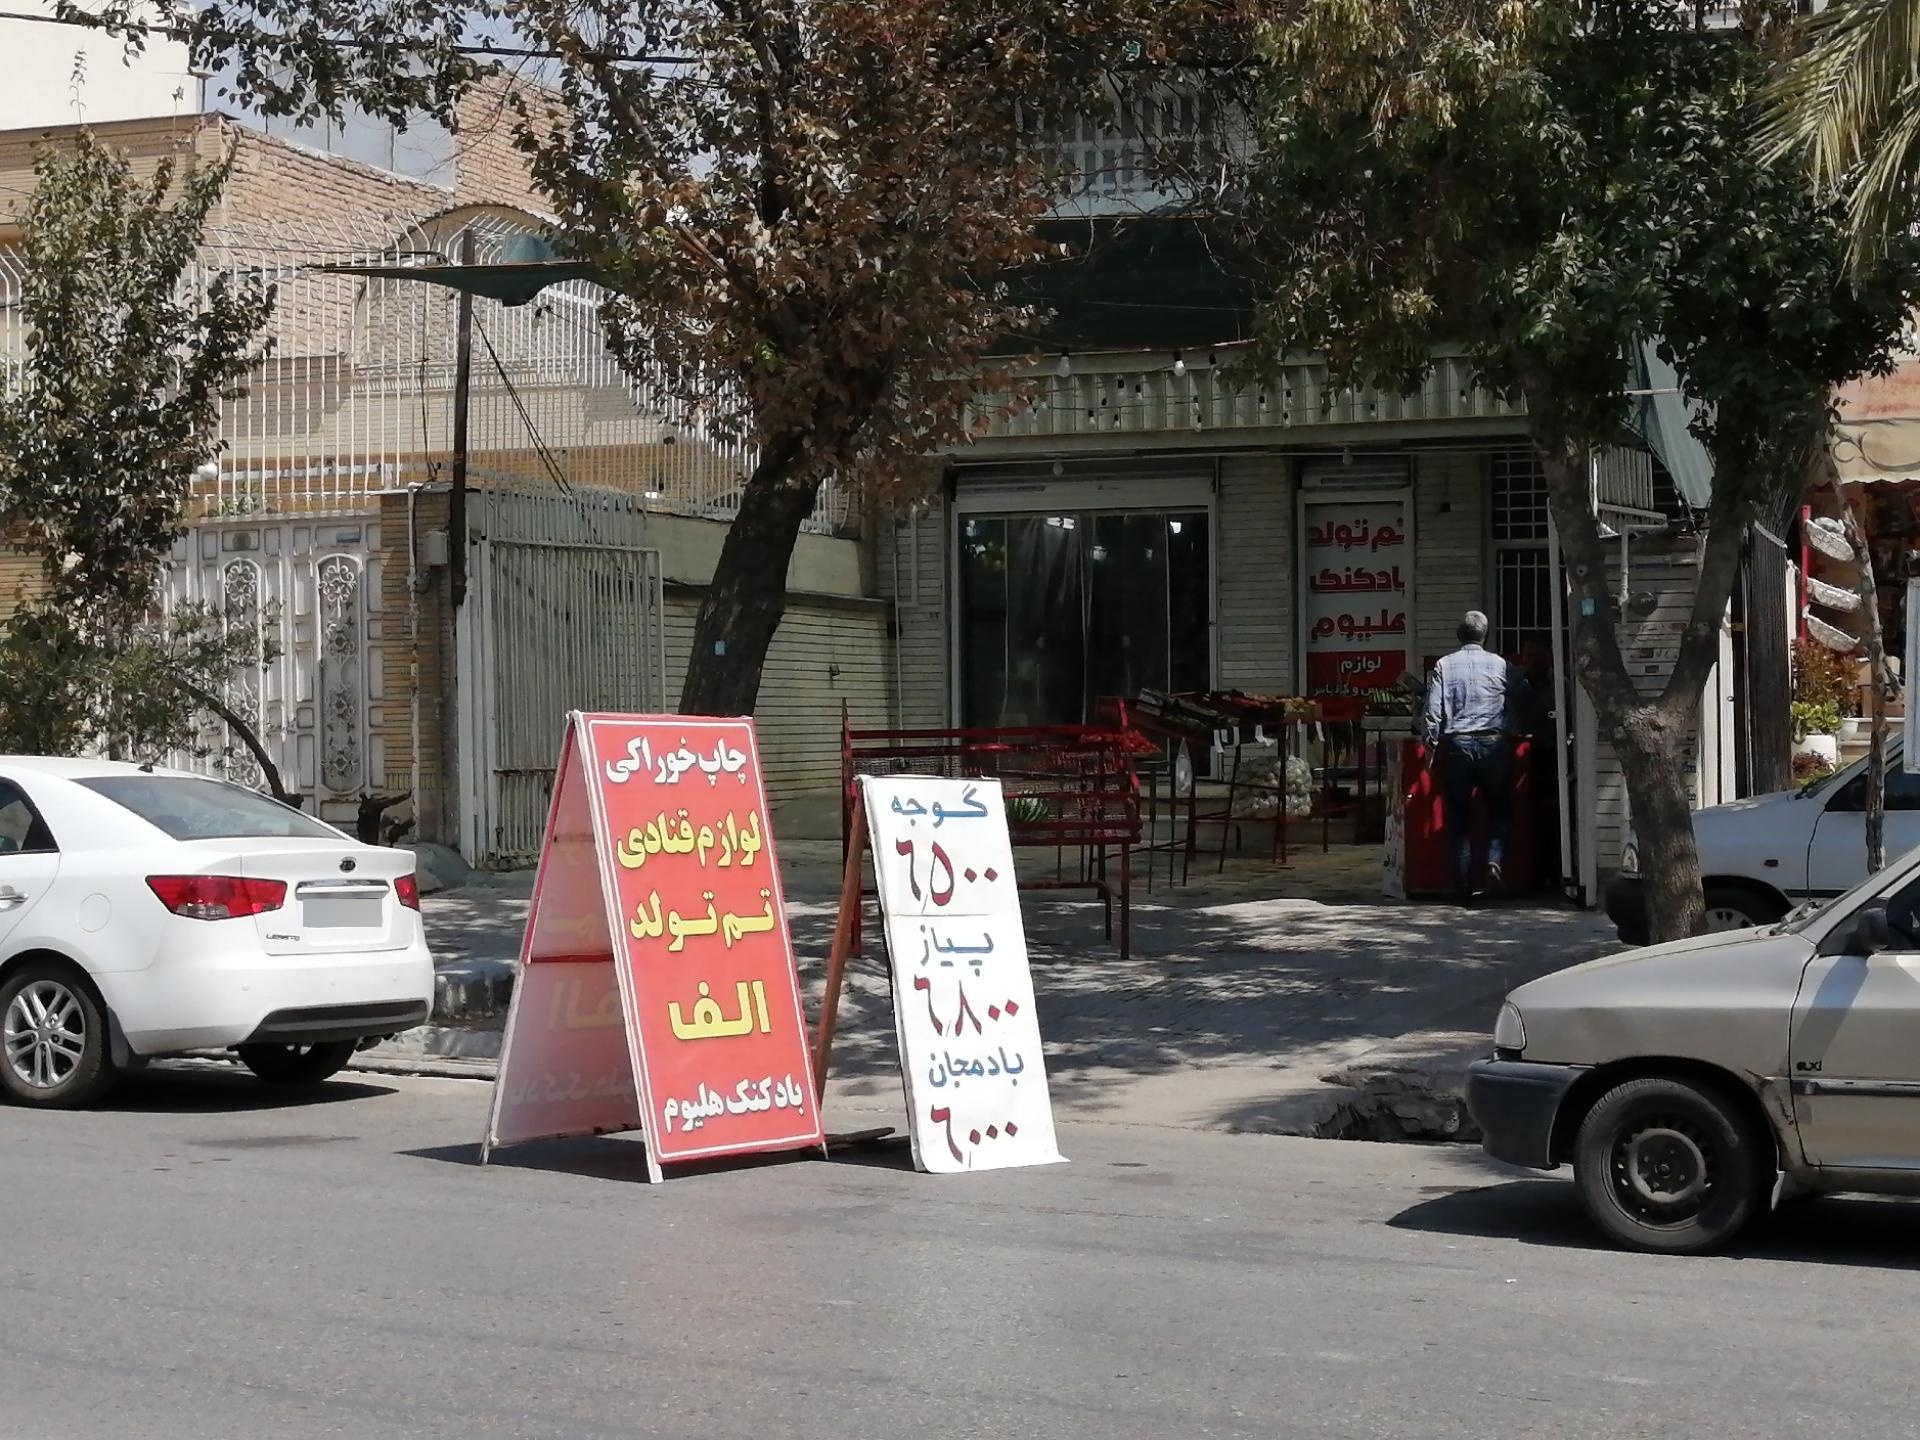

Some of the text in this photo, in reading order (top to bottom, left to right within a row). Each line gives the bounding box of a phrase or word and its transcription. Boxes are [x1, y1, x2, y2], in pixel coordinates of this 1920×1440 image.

[1307, 517, 1369, 552] تولد
[1341, 655, 1382, 674] لوازم
[605, 736, 747, 786] چاپ خوراکی
[617, 807, 762, 869] لوازم قنادی
[629, 888, 718, 952] تولد
[722, 887, 775, 949] تم
[920, 924, 995, 977] پیاز
[667, 980, 771, 1041] الف
[928, 1046, 1025, 1089] بادمجان
[663, 1081, 724, 1134] هلیوم
[726, 1073, 804, 1117] بادکنک
